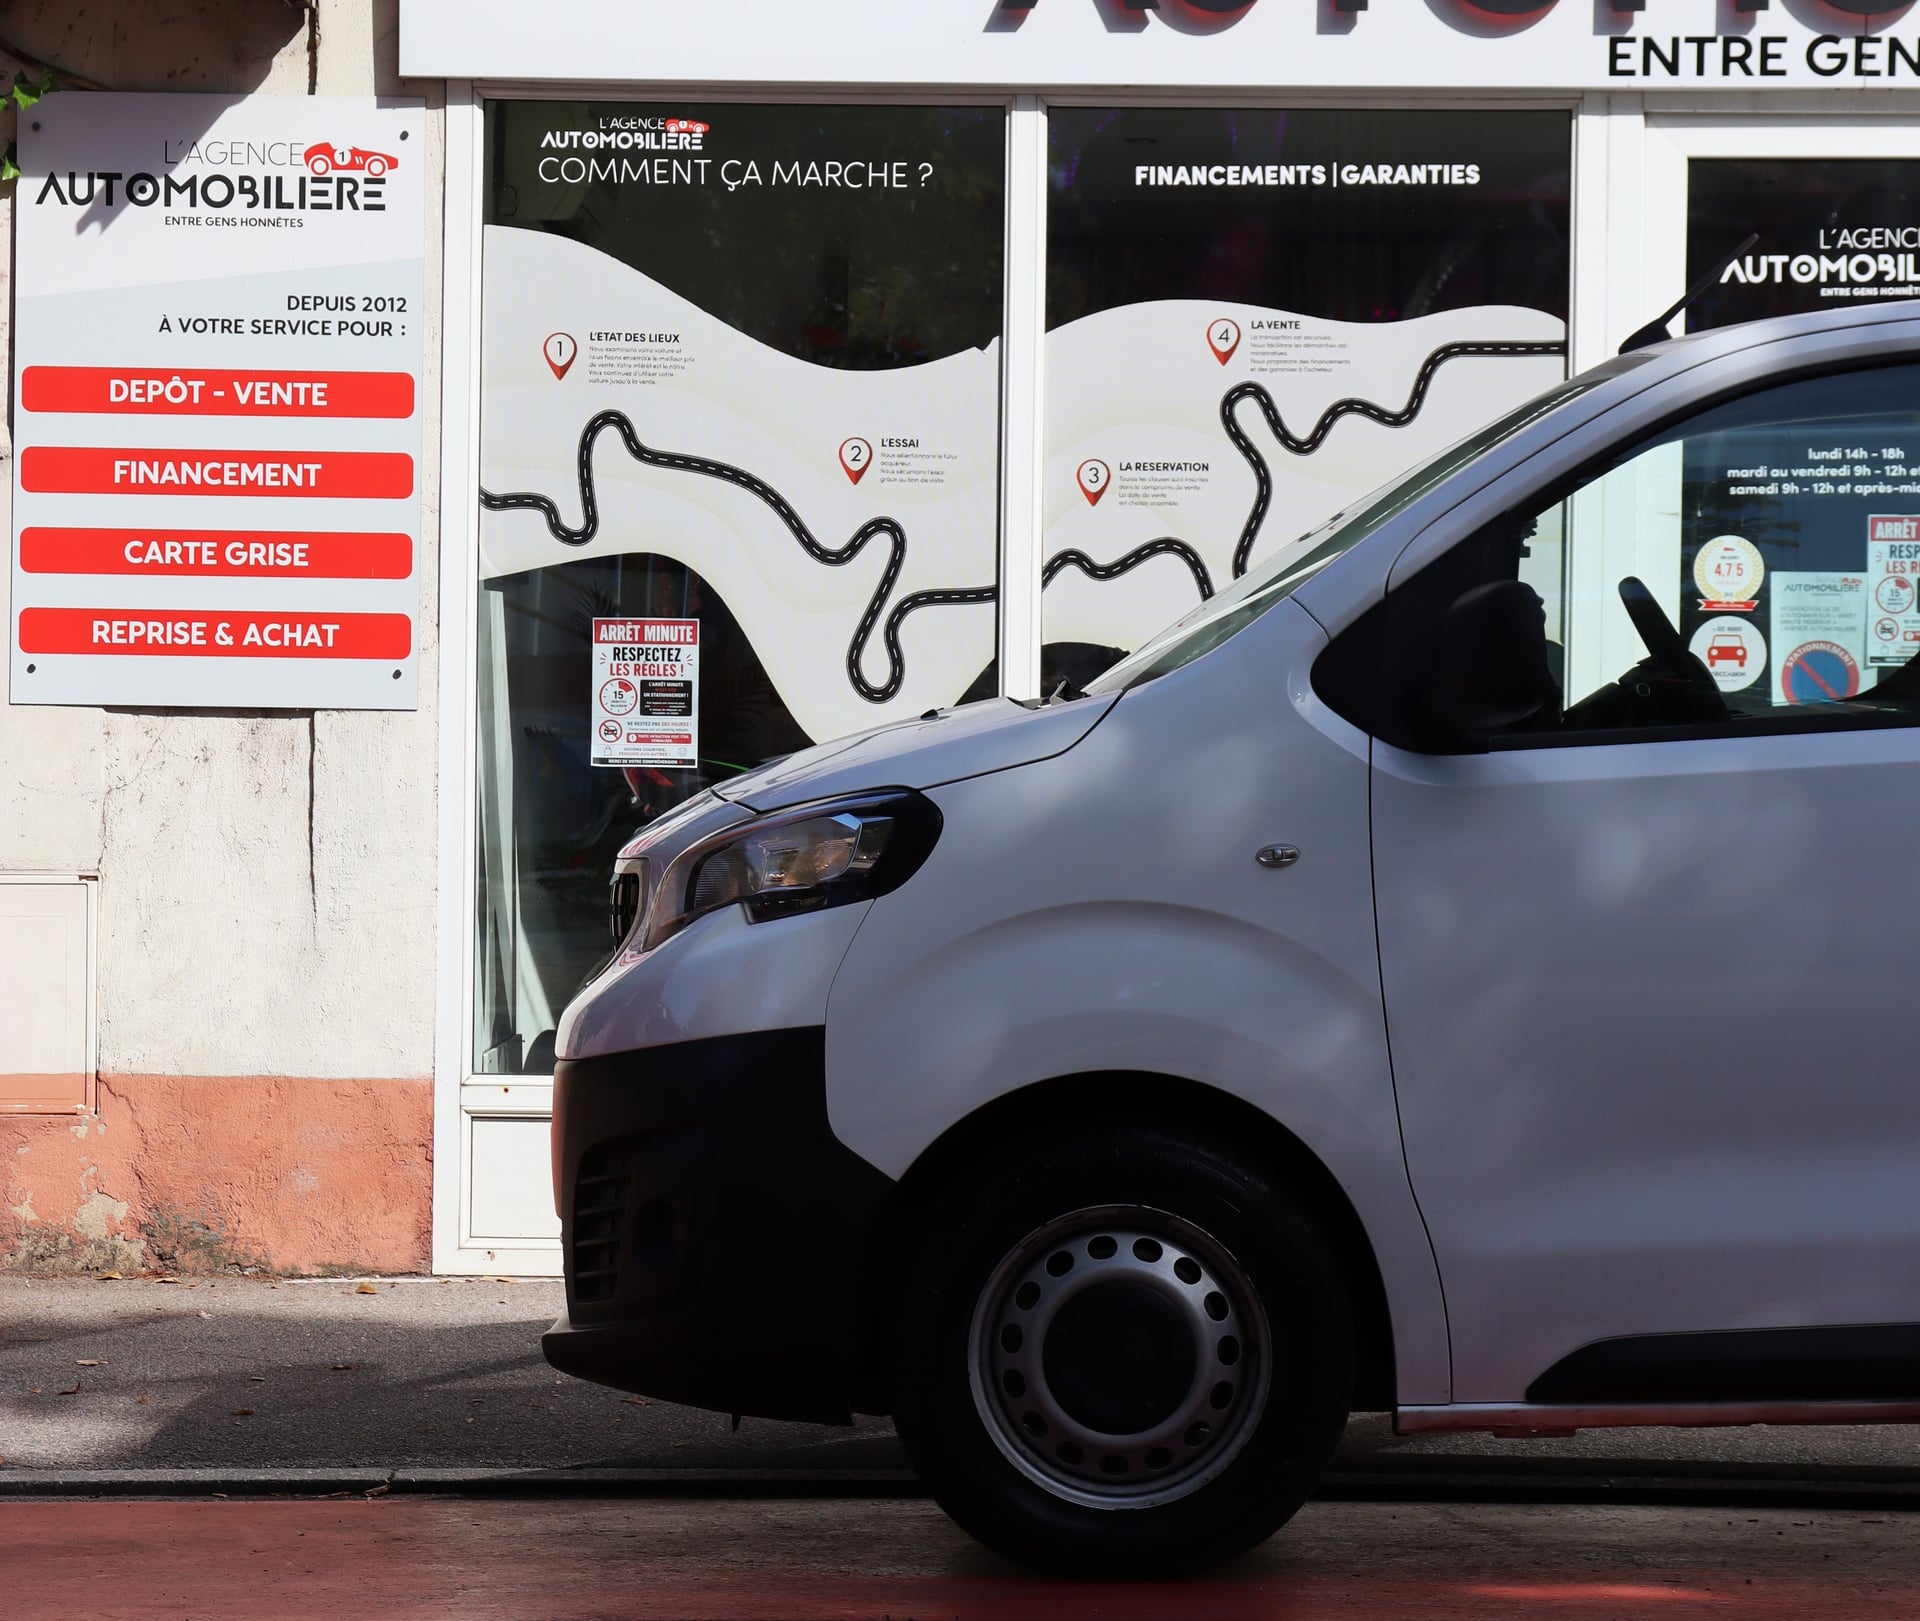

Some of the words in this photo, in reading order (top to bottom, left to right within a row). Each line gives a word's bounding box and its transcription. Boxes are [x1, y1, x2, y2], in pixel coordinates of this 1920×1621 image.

[1609, 36, 1787, 76] ENTRE
[599, 117, 666, 130] L'AGENCE
[165, 141, 304, 166] L'AGENCE
[538, 158, 711, 185] COMMENT
[720, 159, 762, 190] ÇA
[772, 160, 908, 188] MARCHE
[1134, 164, 1326, 186] FINANCEMENTS
[1341, 164, 1481, 185] GARANTIES
[165, 216, 202, 226] ENTRE
[205, 216, 237, 228] GENS
[240, 216, 304, 228] HONNÊTES
[1820, 227, 1920, 249] L'AGENC
[1820, 287, 1851, 296] ENTRE
[1852, 286, 1878, 296] GENS
[1880, 284, 1920, 296] HONNÊT
[287, 296, 356, 312] DEPUIS
[362, 296, 408, 312] 2012
[158, 314, 172, 334] À
[179, 318, 244, 334] VOTRE
[251, 319, 332, 336] SERVICE
[338, 320, 393, 336] POUR
[1251, 320, 1264, 330] LA
[1268, 320, 1300, 330] VENTE
[590, 332, 622, 342] L'ETAT
[624, 332, 646, 342] DES
[649, 334, 680, 343] LIEUX
[1218, 327, 1230, 342] 4
[556, 340, 562, 357] 1
[109, 376, 206, 404] DEPÔT
[233, 382, 328, 406] VENTE
[881, 438, 919, 448] L'ESSAI
[850, 446, 862, 462] 2
[1808, 448, 1842, 460] lundi
[1845, 448, 1868, 459] 14h
[1881, 448, 1904, 459] 18h
[114, 460, 322, 487] FINANCEMENT
[1120, 462, 1132, 471] LA
[1135, 462, 1210, 472] RESERVATION
[1727, 466, 1768, 478] mardi
[1770, 468, 1788, 478] au
[1791, 465, 1850, 477] vendredi
[1854, 465, 1871, 476] 9h
[1884, 464, 1907, 476] 12h
[1089, 467, 1099, 484] 3
[1729, 484, 1778, 495] samedi
[1782, 483, 1799, 494] 9h
[1813, 483, 1834, 494] 12h
[1838, 483, 1851, 494] et
[1875, 518, 1918, 538] ARRÊT
[124, 540, 217, 565] CARTE
[224, 542, 309, 567] GRISE
[1886, 561, 1906, 573] LES
[1890, 589, 1900, 597] 15
[92, 620, 207, 646] REPRISE
[214, 622, 234, 646] &
[242, 623, 340, 648] ACHAT
[600, 622, 640, 641] ARRÊT
[644, 624, 693, 642] MINUTE
[613, 647, 681, 662] RESPECTEZ
[1786, 642, 1854, 668] STATIONNEMENT
[610, 663, 630, 676] LES
[634, 661, 677, 677] RÈGLES
[613, 691, 624, 699] 15
